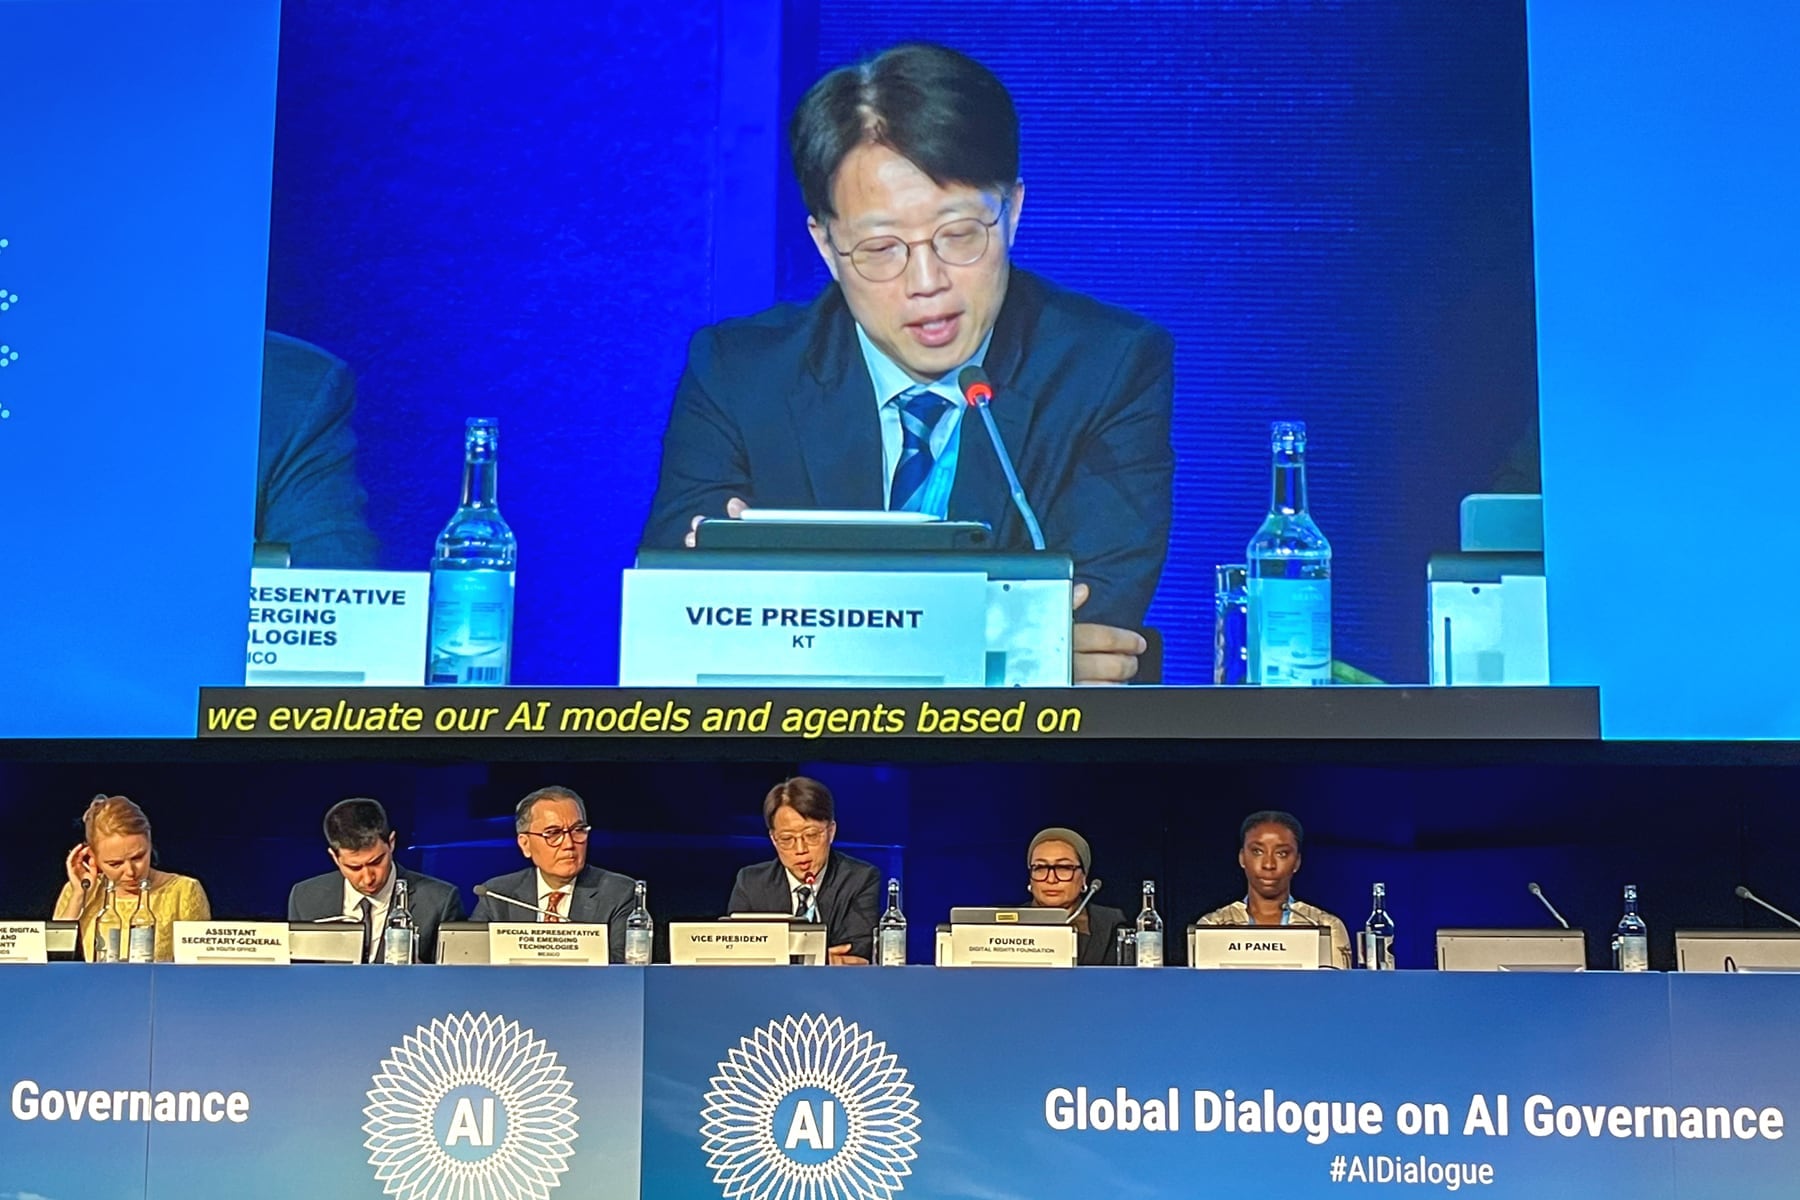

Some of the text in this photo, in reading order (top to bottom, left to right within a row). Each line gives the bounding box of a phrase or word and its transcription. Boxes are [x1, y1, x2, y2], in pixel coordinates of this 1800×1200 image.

[249, 607, 337, 625] ERGING
[686, 607, 923, 628] VICE PRESIDENT
[248, 629, 338, 646] LOGIES
[792, 635, 815, 649] KT
[207, 700, 1081, 738] we evaluate our AI models and agents based on
[205, 928, 257, 936] ASSISTANT
[531, 929, 600, 937] REPRESENTATIVE
[690, 935, 769, 943] VICE PRESIDENT
[181, 937, 282, 946] SECRETARY-GENERAL
[518, 943, 579, 951] TECHNOLOGIES
[989, 937, 1035, 946] FOUNDER
[1228, 942, 1287, 951] AI PANEL
[11, 1080, 250, 1123] Governance
[445, 1098, 495, 1147] AI
[1045, 1087, 1784, 1145] Global Dialogue on AI Governance
[784, 1100, 835, 1150] AI
[1329, 1155, 1495, 1191] #AIDialogue
